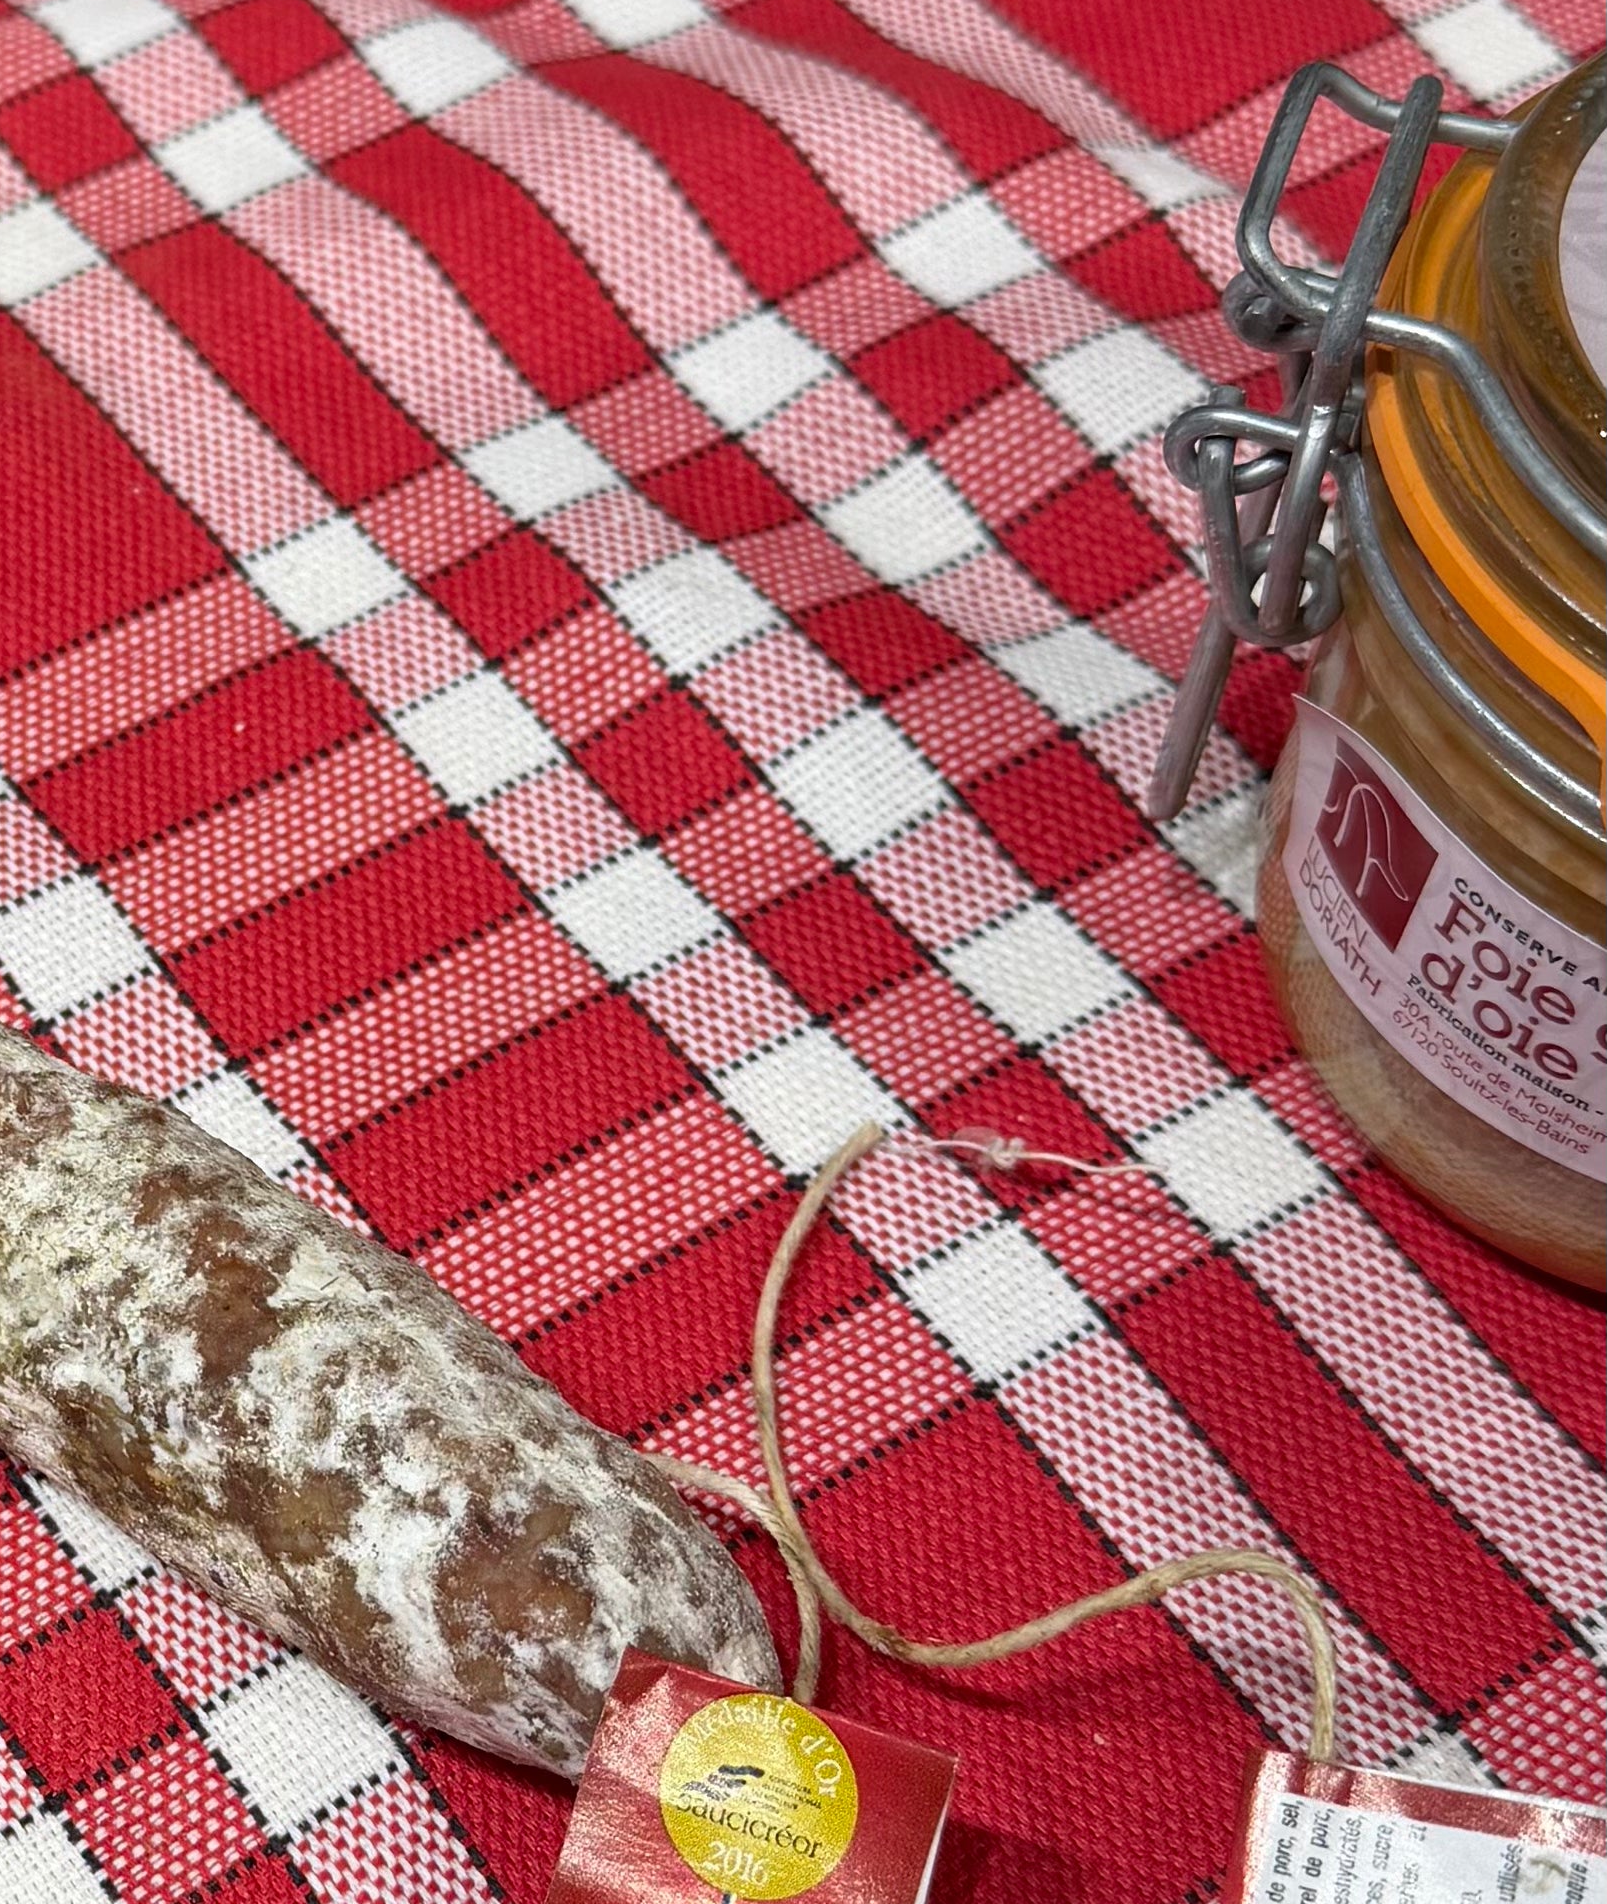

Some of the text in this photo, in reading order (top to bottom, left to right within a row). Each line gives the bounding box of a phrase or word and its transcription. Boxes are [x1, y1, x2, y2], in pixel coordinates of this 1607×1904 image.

[1306, 836, 1369, 948] LUCIEN
[1299, 859, 1382, 997] DORIATH
[1434, 892, 1576, 1026] Foie
[1454, 877, 1578, 976] CONSERVE
[1399, 995, 1432, 1032] 30A
[1434, 1029, 1484, 1073] route
[1487, 1069, 1510, 1094] de
[1407, 973, 1508, 1067] Fabrication
[1512, 1060, 1590, 1115] maison
[1420, 952, 1578, 1081] d'oie
[1392, 1011, 1590, 1156] 67120 Soultz-les-Bains
[800, 1735, 842, 1798] d'Or
[677, 1791, 823, 1859] Saucicréor
[1279, 1797, 1305, 1829] sel,
[1311, 1806, 1336, 1848] porc,
[1373, 1819, 1398, 1870] sucre,
[703, 1840, 770, 1889] 2016
[1274, 1834, 1298, 1876] porc,
[1303, 1856, 1324, 1878] de
[1495, 1841, 1525, 1903] utilisés
[1266, 1881, 1287, 1903] de
